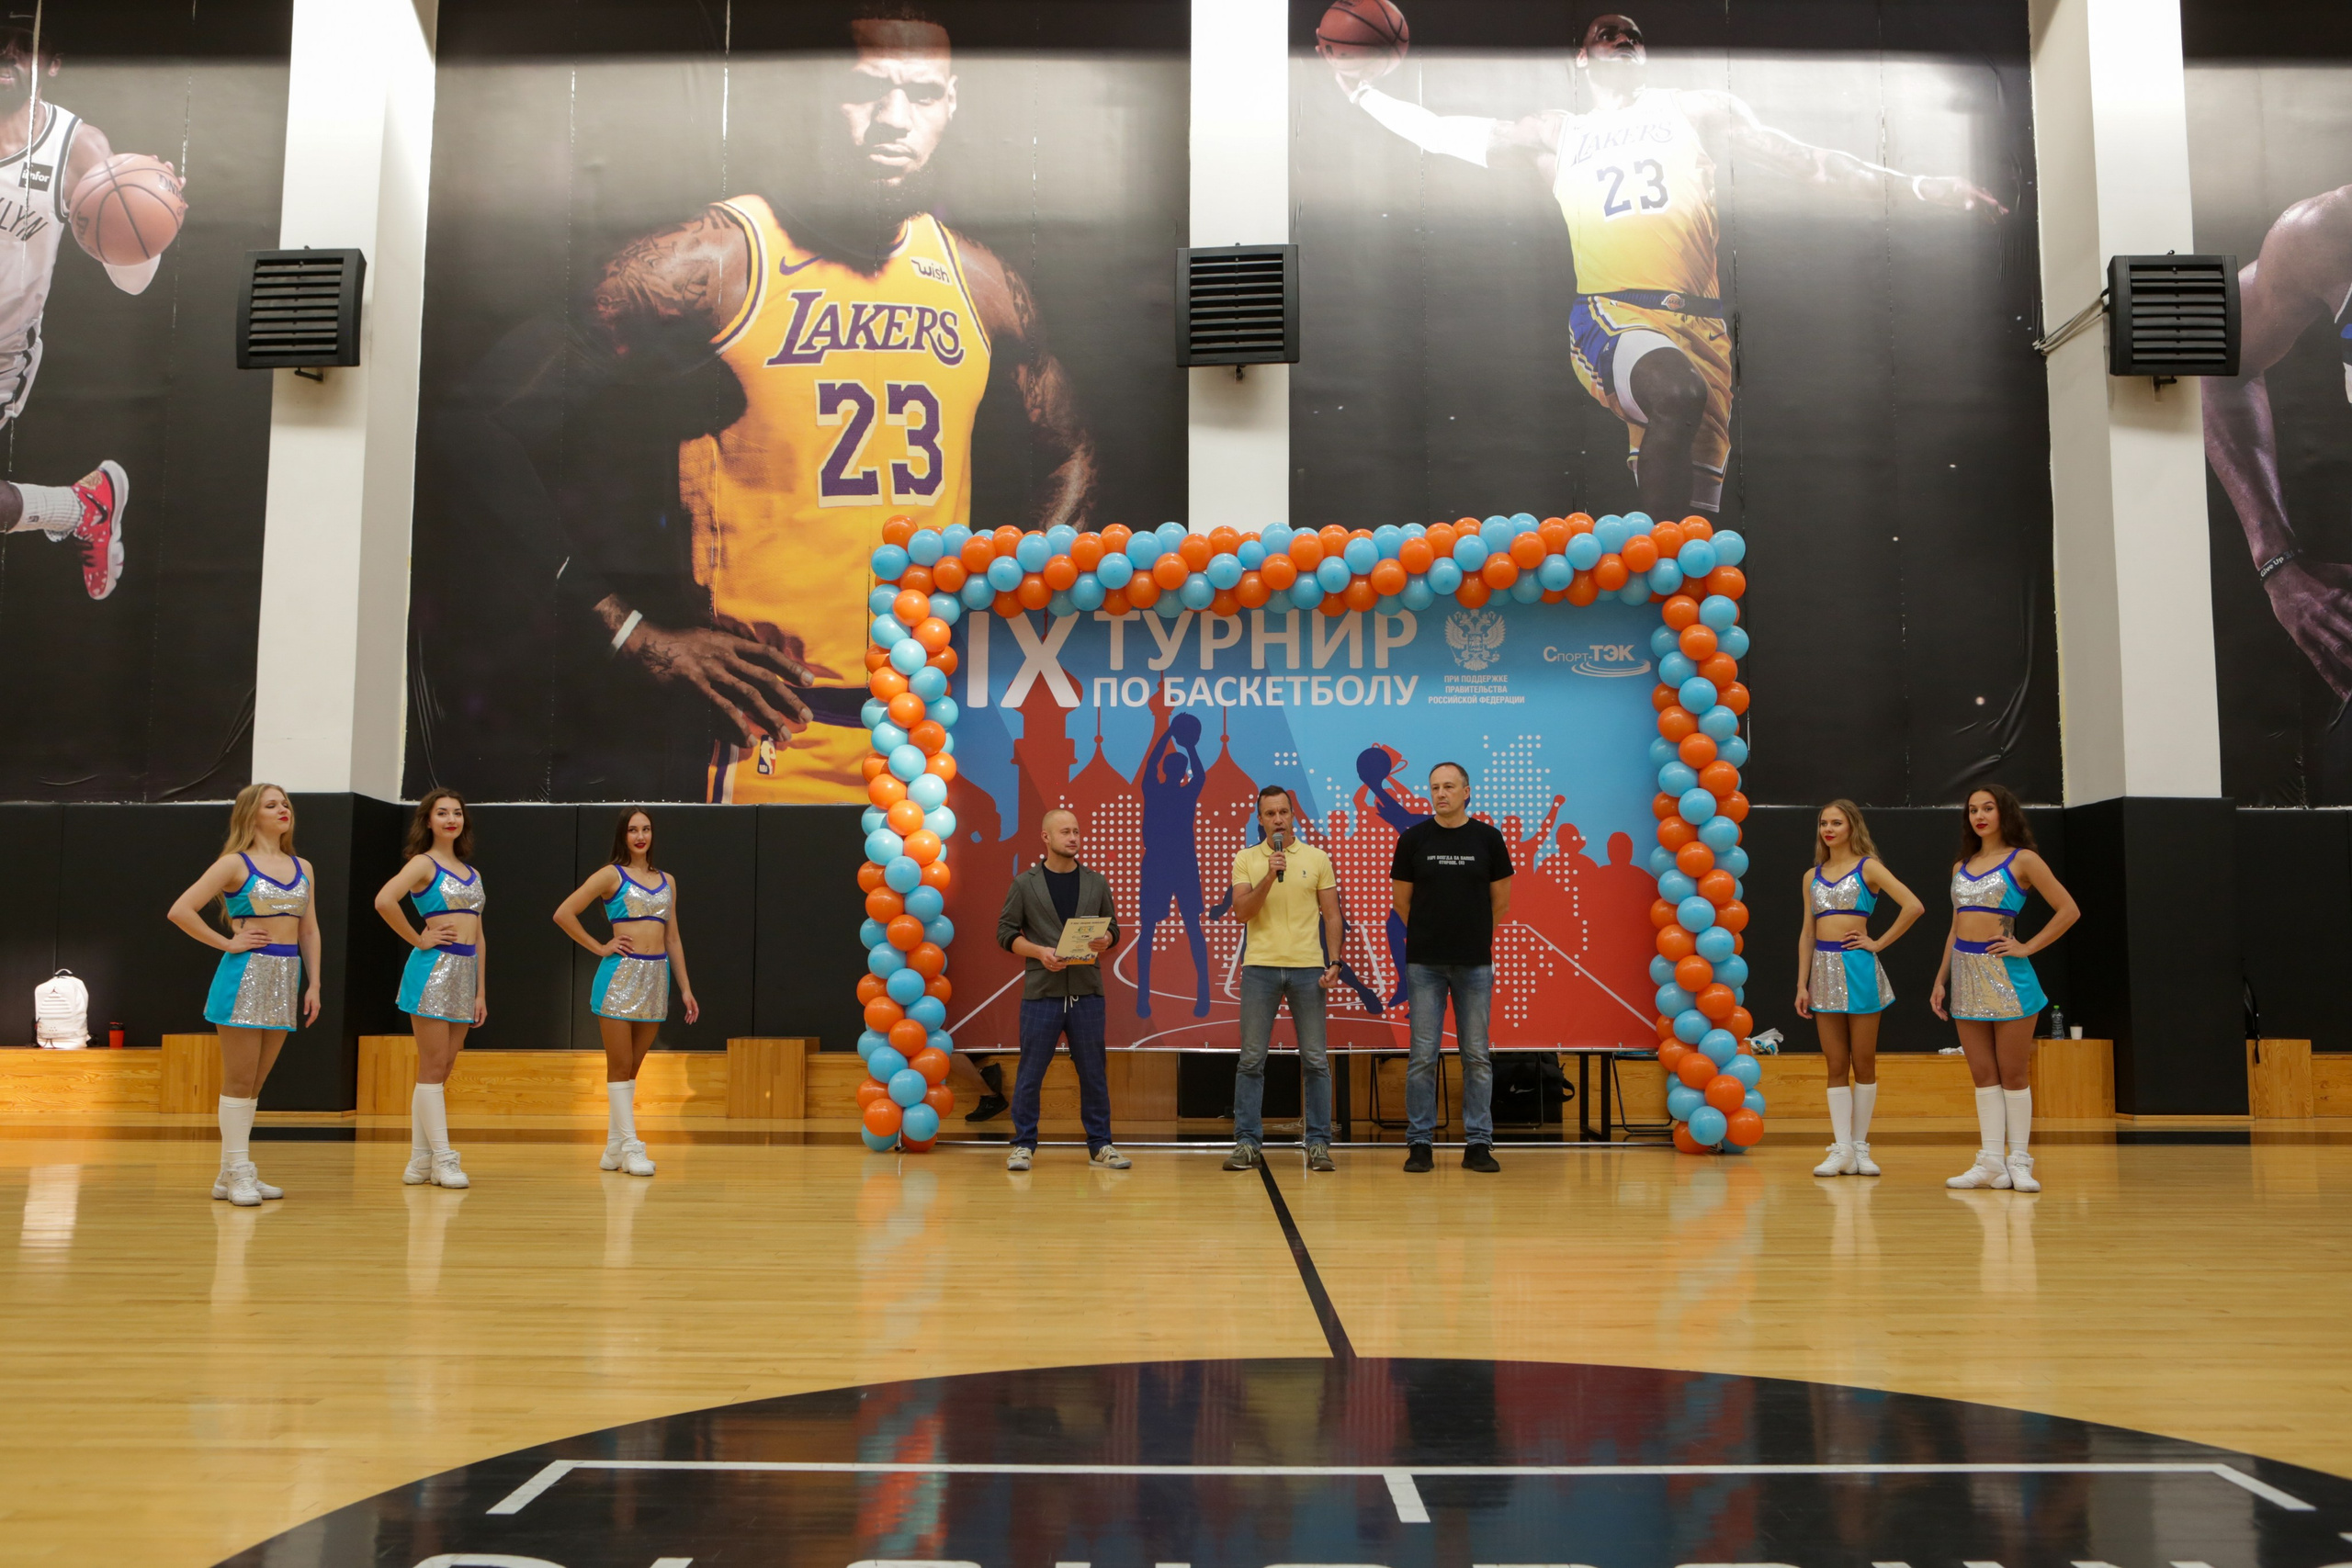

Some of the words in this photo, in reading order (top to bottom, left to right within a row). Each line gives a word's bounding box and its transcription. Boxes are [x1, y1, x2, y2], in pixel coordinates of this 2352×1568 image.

[1570, 121, 1673, 166] LAKERS
[1596, 158, 1669, 219] 23
[763, 289, 965, 367] LAKERS
[815, 379, 944, 506] 23
[967, 610, 1080, 708] IX
[1093, 608, 1418, 671] ТУРНИР
[1093, 677, 1150, 707] ПО
[1163, 675, 1419, 707] БАСКЕТБОЛУ
[1428, 695, 1477, 704] РОССИЙСКОЙ
[1479, 695, 1525, 705] ФЕДЕРАЦИИ
[1445, 685, 1508, 694] ПРАВИТЕЛЬСТВА
[1461, 675, 1508, 683] ПОДДЕРЖКЕ
